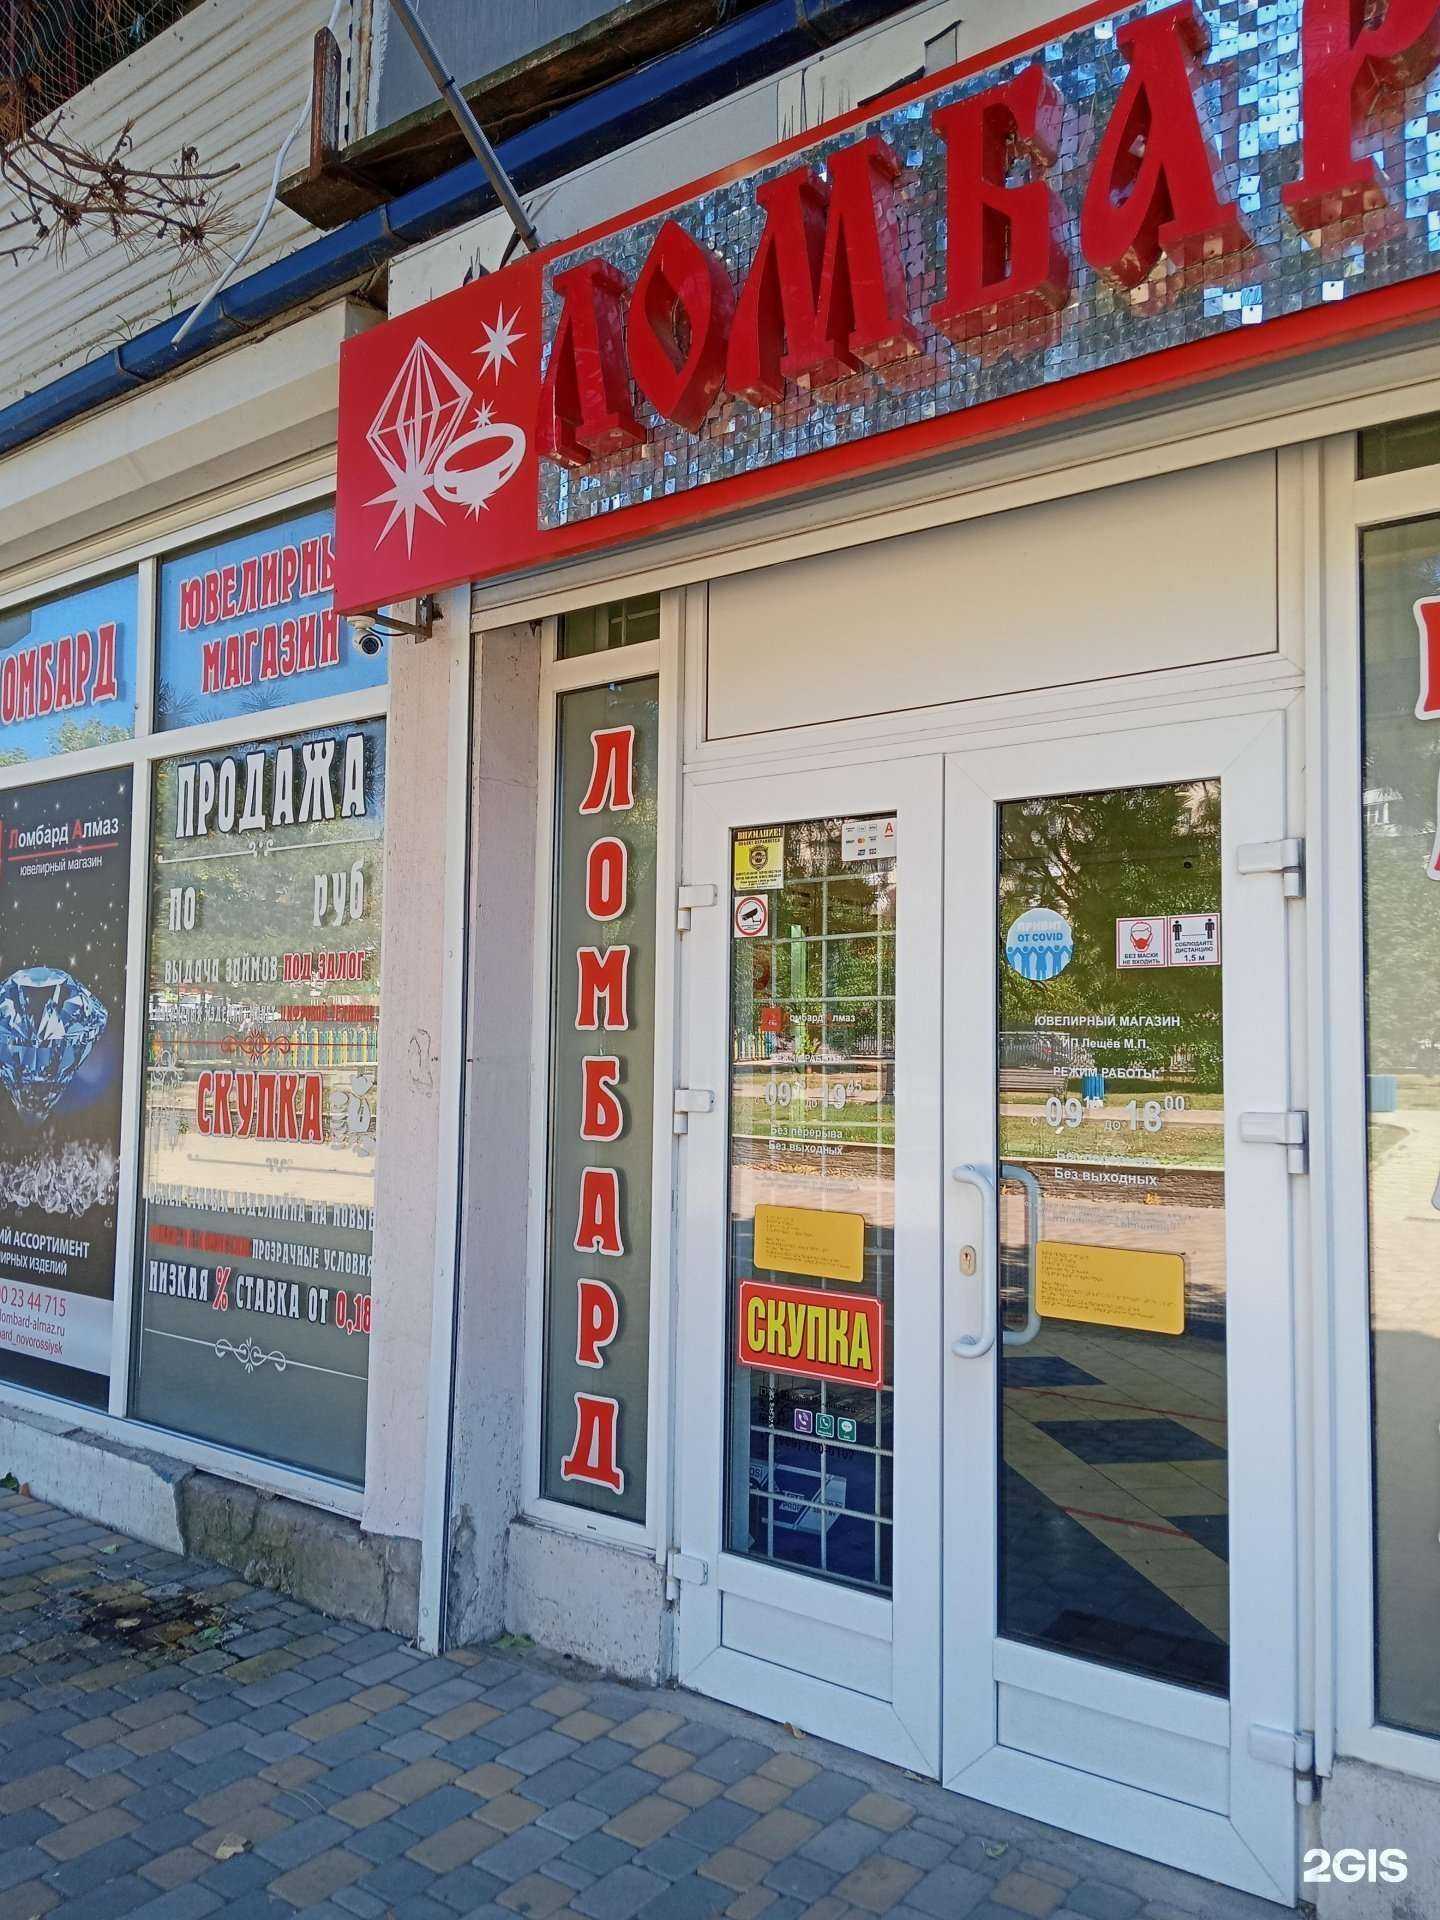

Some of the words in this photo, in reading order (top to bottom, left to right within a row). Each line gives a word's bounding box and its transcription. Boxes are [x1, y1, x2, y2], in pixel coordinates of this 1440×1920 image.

[201, 608, 340, 694] МАГАЗИН
[176, 732, 366, 839] ПРОДАЖА
[9, 822, 69, 849] Ломбард
[72, 818, 119, 838] Алмаз
[67, 856, 103, 870] магазин
[1032, 932, 1063, 942] COVID
[1034, 1015, 1116, 1027] ЮВЕЛИРНЫЙ
[1119, 1015, 1180, 1027] МАГАЗИН
[1053, 1066, 1097, 1077] РЕЖИМ
[197, 1071, 323, 1144] СКУПКА
[562, 725, 637, 1497] ЛОМБАРД
[1054, 1166, 1079, 1181] Без
[1083, 1170, 1158, 1186] выходных
[13, 1230, 90, 1258] АССОРТИМЕНТ
[251, 1238, 320, 1269] ПРОЗРАЧНЫЕ
[29, 1256, 67, 1276] ИЗДЕЛИЙ
[10, 1287, 24, 1308] 23
[27, 1292, 41, 1312] 44
[44, 1295, 66, 1318] 715
[149, 1260, 209, 1302] НИЗКАЯ
[212, 1265, 232, 1311] %
[235, 1274, 300, 1319] СТАВКА
[308, 1286, 329, 1324] ОТ
[748, 1296, 873, 1371] СКУПКА
